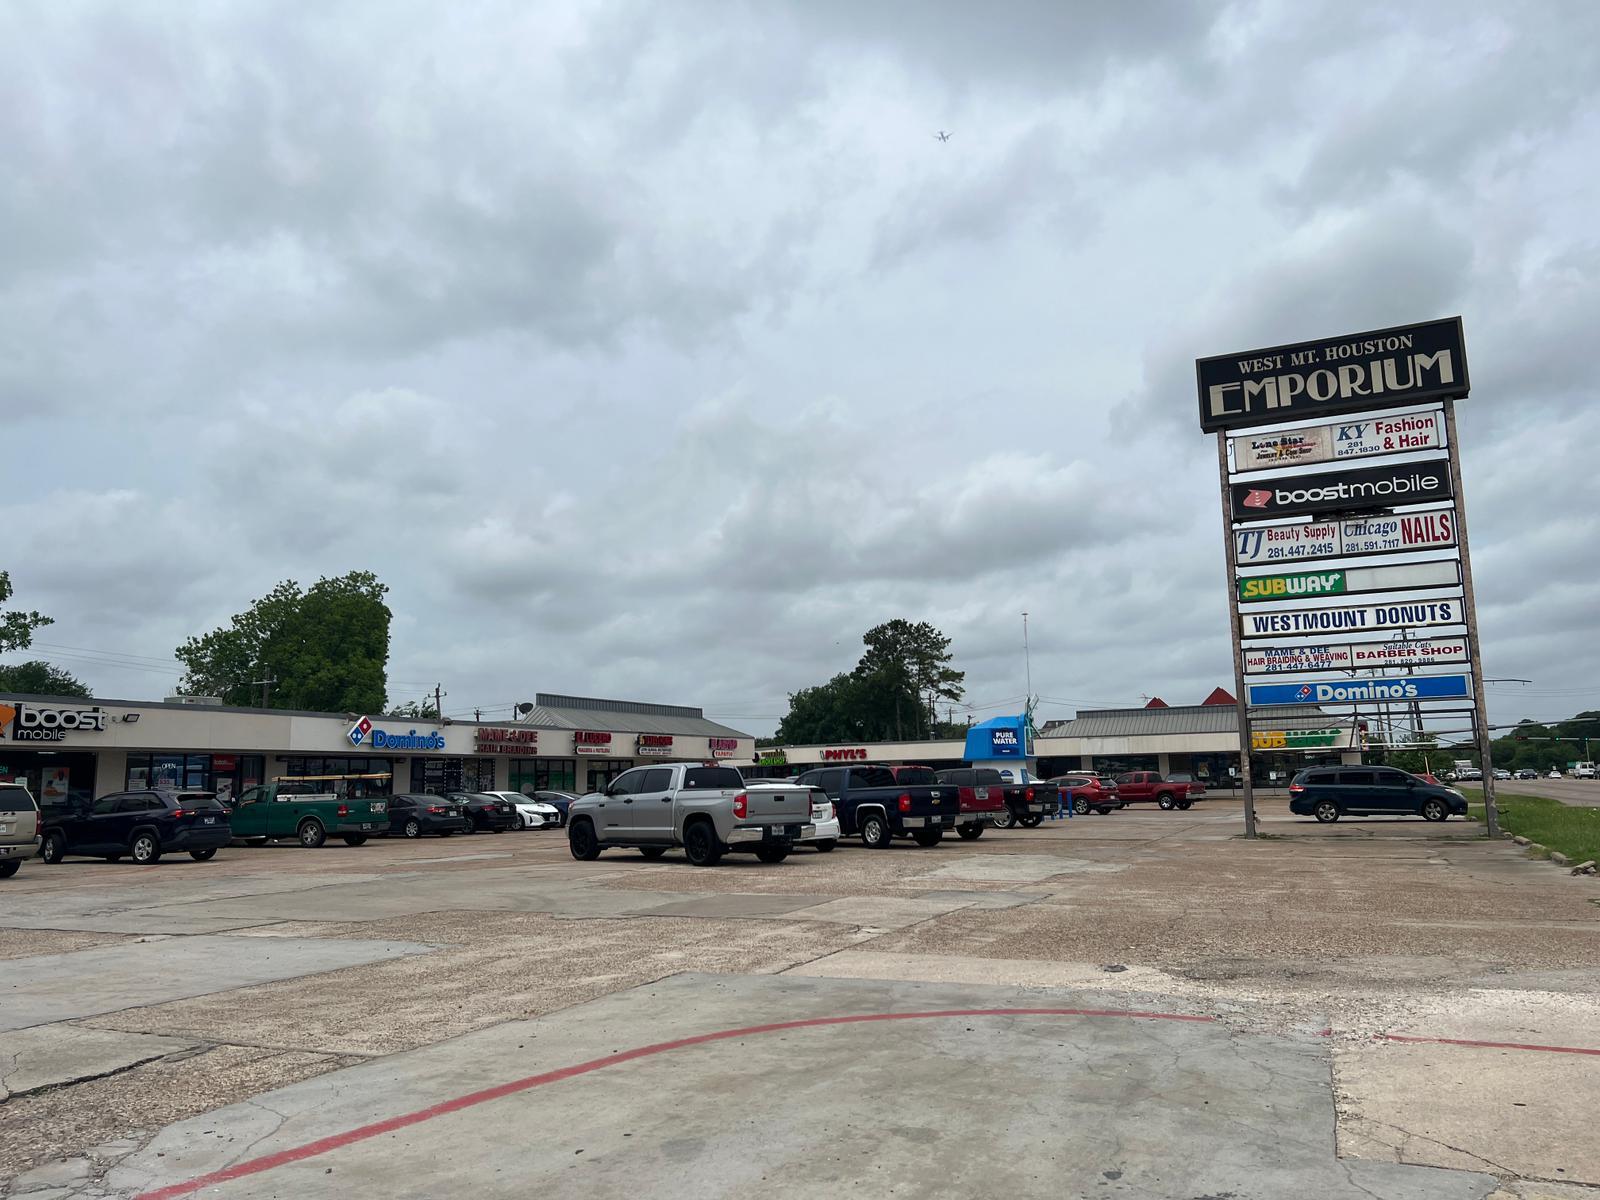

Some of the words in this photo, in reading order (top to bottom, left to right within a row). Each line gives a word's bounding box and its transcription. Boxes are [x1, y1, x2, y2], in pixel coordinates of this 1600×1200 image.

[1238, 355, 1284, 374] WEST
[1291, 350, 1320, 368] MT.
[1325, 334, 1413, 361] HOUSTON
[1209, 349, 1454, 417] EMPORIUM
[1336, 423, 1370, 441] KY
[1375, 415, 1434, 435] Fashion
[1337, 445, 1380, 456] 847.1830
[1382, 437, 1395, 450] &
[1399, 432, 1430, 448] Hair
[1275, 474, 1439, 505] boostmobile
[1344, 520, 1397, 538] Chicago
[1401, 513, 1451, 545] NAILS
[1238, 530, 1265, 559] TJ
[1267, 528, 1300, 542] Beauty
[1304, 524, 1336, 540] Supply
[1268, 543, 1334, 558] 281.447.2415
[1345, 539, 1400, 552] 281.591.7117
[1242, 574, 1341, 598] SUBWAY
[1252, 610, 1367, 633] WESTMOUNT
[1376, 603, 1452, 625] DONUTS
[1247, 657, 1265, 666] HAIR
[1266, 655, 1302, 665] BRAIDING
[1312, 652, 1348, 662] WEAVING
[1265, 648, 1295, 657] MAME
[1299, 647, 1306, 656] &
[1310, 646, 1330, 654] DEE
[1355, 648, 1417, 660] BARBER
[1420, 645, 1463, 656] SHOP
[1265, 660, 1332, 672] 281-447-6477
[1316, 679, 1418, 701] Domino's
[21, 704, 107, 729] boost
[18, 729, 67, 740] mobile
[372, 730, 445, 749] Domino's
[993, 738, 1019, 746] WATER
